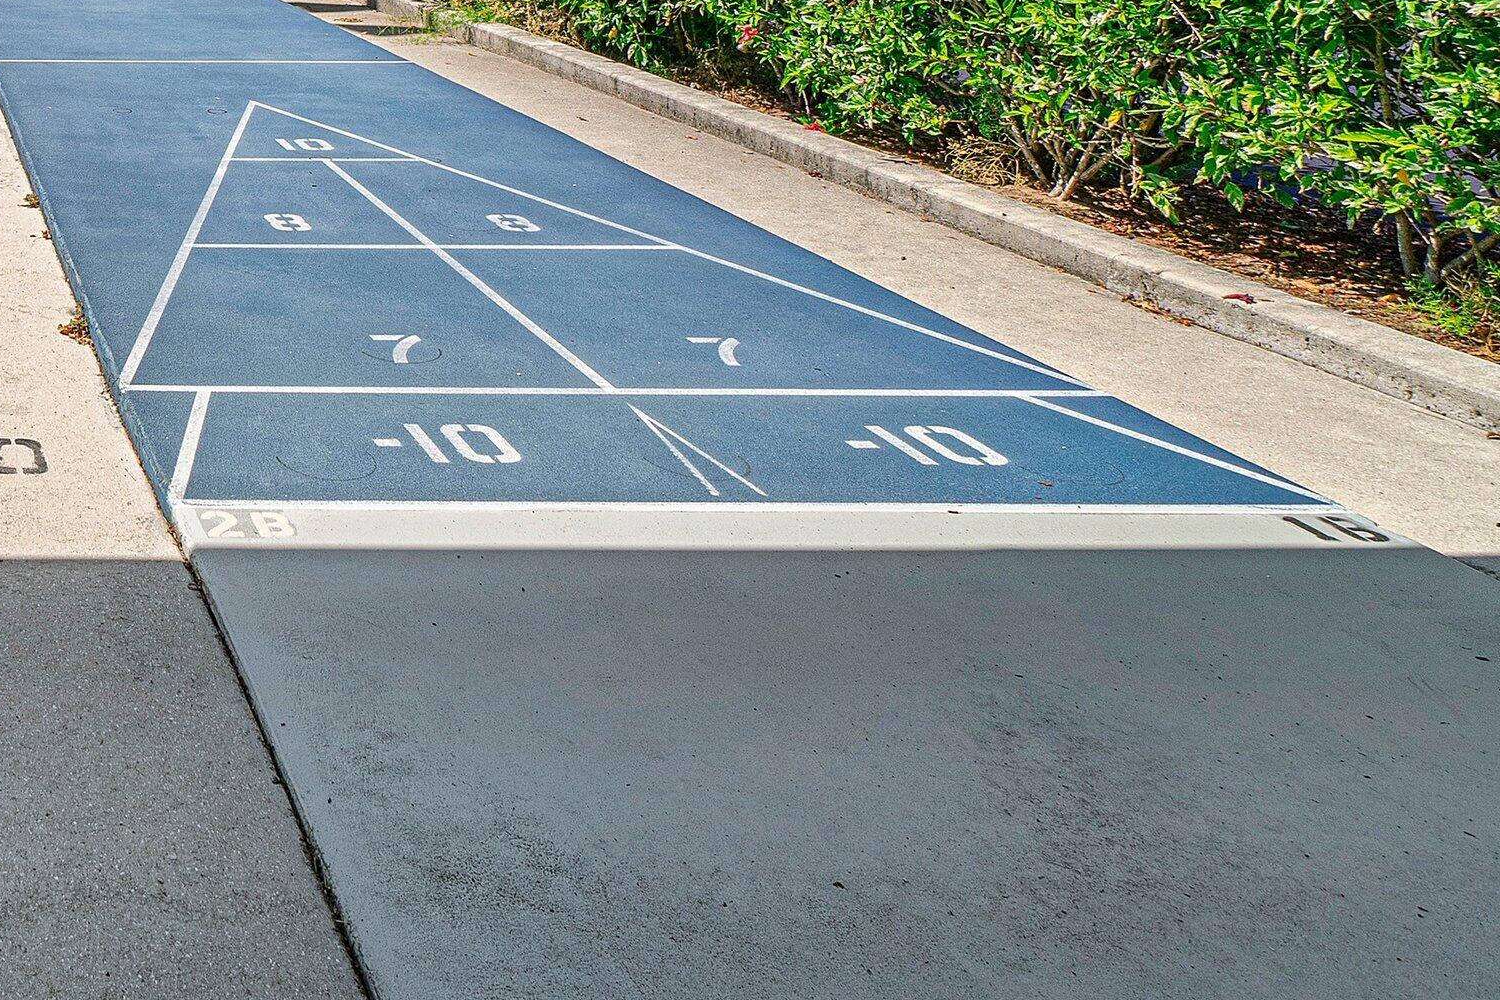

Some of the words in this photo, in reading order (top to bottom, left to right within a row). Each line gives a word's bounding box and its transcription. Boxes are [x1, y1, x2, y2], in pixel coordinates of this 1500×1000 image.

[274, 138, 336, 152] 10
[264, 213, 313, 232] 8
[485, 213, 542, 232] 8
[368, 334, 422, 364] 7
[685, 336, 742, 367] 7
[372, 422, 524, 464] -10
[844, 425, 1009, 466] -10
[200, 510, 296, 538] 2B
